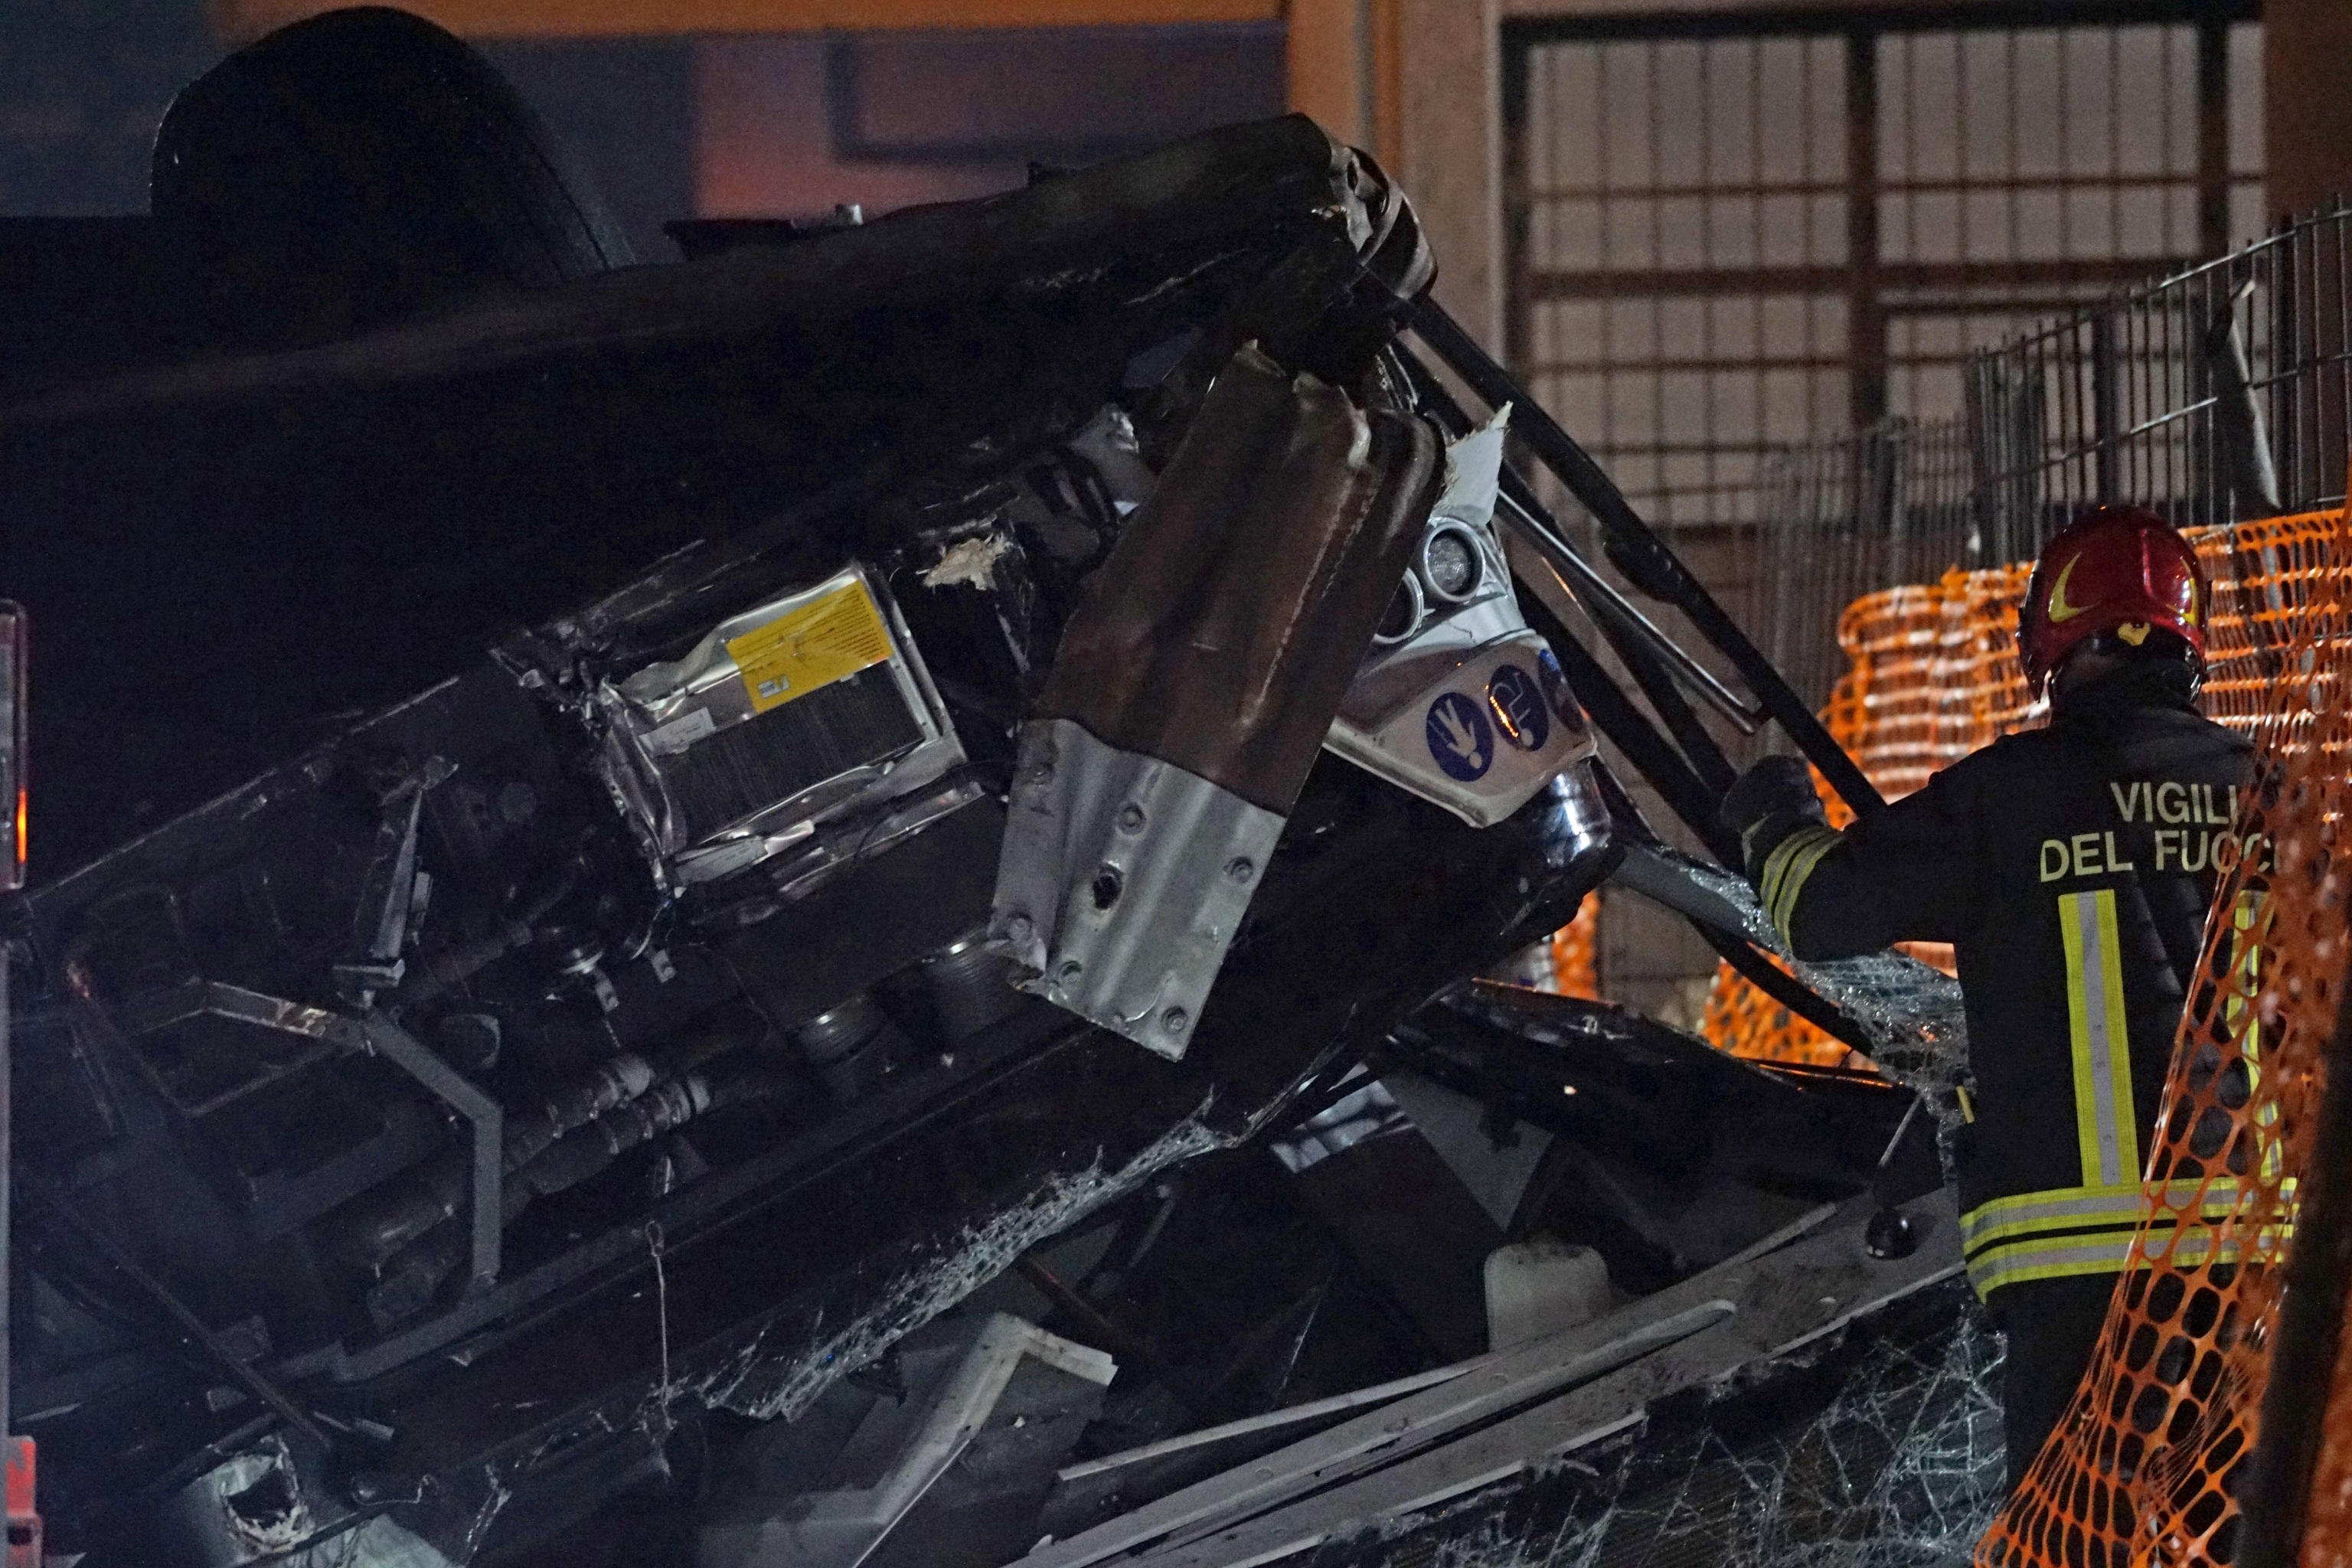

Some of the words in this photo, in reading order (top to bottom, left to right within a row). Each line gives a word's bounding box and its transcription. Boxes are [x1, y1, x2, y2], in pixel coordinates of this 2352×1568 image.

[2110, 782, 2239, 825] VIGILI
[2040, 831, 2133, 883] DEL
[2154, 830, 2285, 873] FUOC
